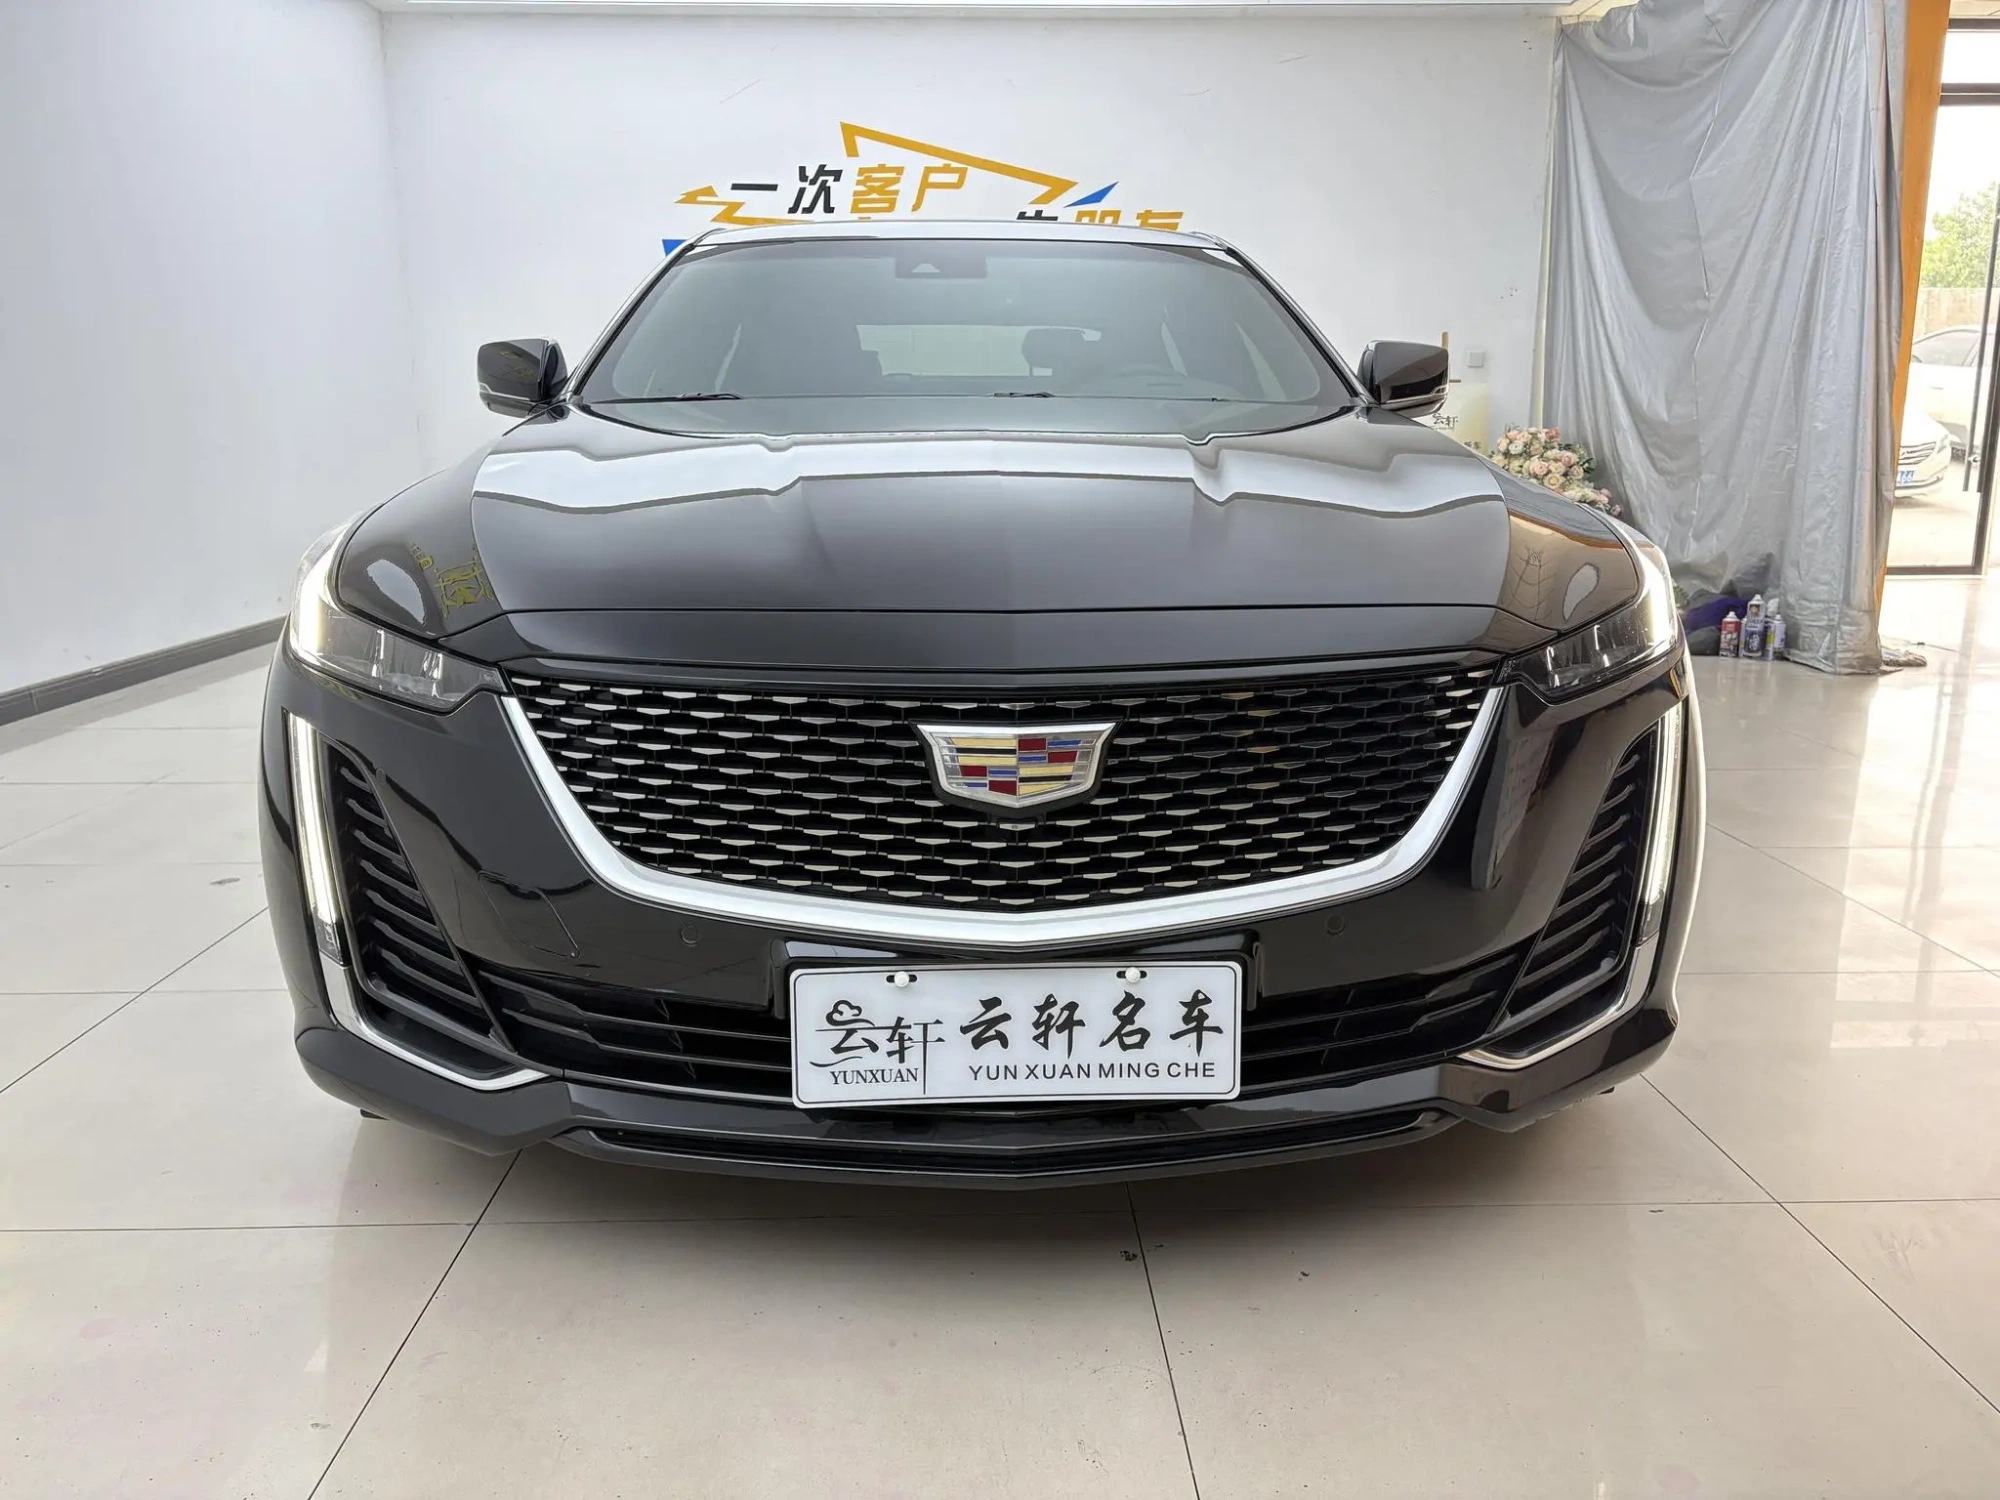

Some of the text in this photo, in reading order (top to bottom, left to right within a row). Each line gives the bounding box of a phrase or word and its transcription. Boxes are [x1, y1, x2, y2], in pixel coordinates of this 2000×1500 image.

[730, 163, 969, 215] 一次客户
[959, 988, 1225, 1059] 云轩名车
[830, 1067, 919, 1085] YUNXUAN
[968, 1062, 1216, 1081] YUN XUAN MING CHE
